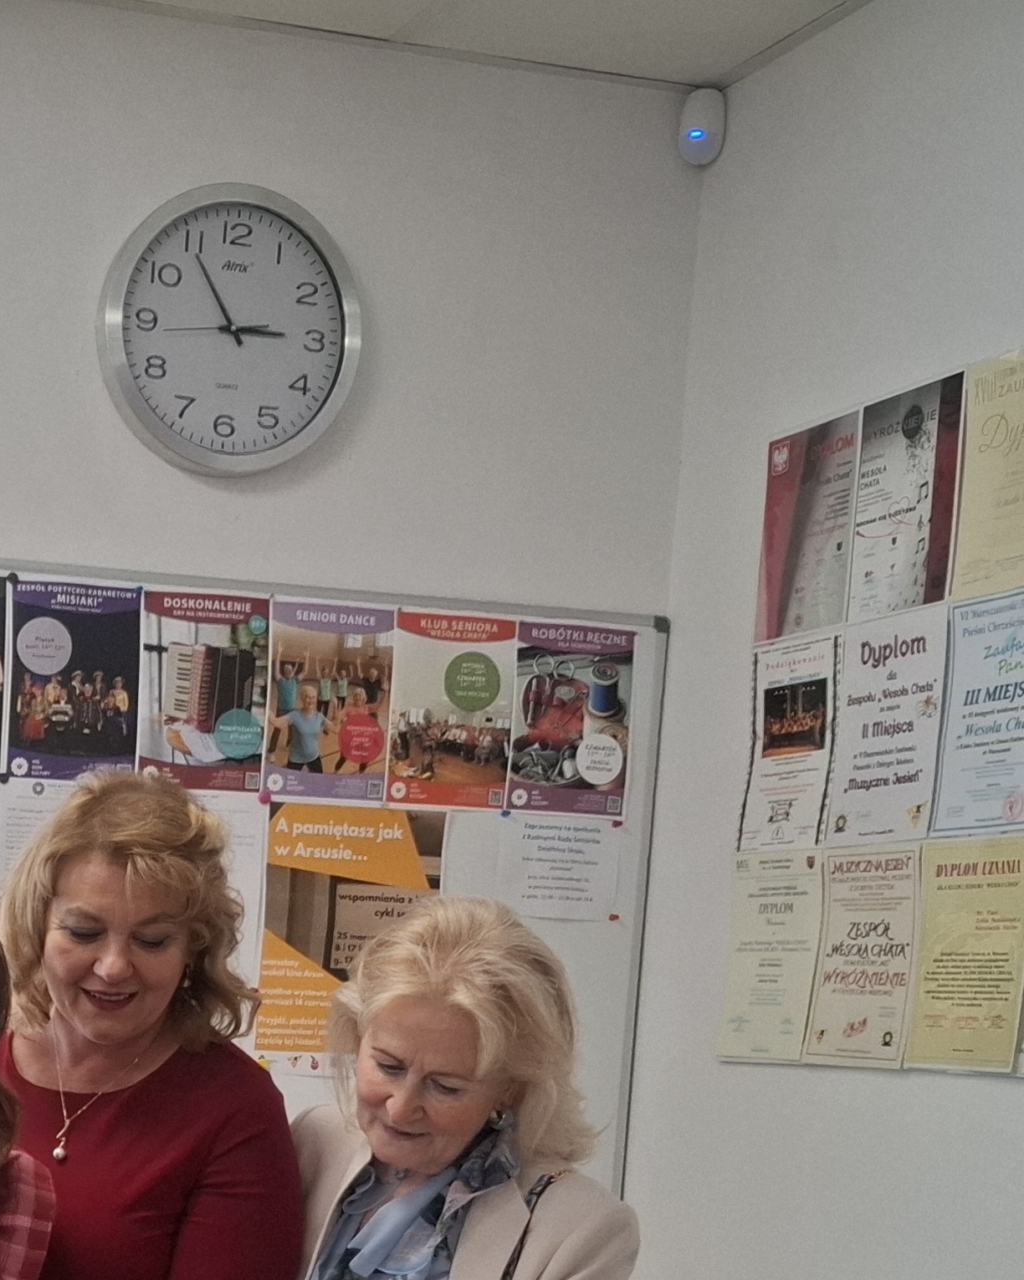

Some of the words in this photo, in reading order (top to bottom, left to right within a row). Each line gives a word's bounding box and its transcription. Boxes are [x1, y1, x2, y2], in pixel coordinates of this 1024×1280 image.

[184, 228, 204, 254] 11
[222, 219, 254, 248] 12
[276, 240, 283, 265] 1
[150, 260, 182, 288] 10
[295, 281, 319, 307] 2
[134, 307, 159, 333] 9
[302, 329, 326, 354] 3
[143, 355, 168, 380] 8
[287, 373, 311, 396] 4
[174, 394, 196, 419] 7
[256, 405, 280, 430] 5
[212, 414, 236, 438] 6
[163, 597, 252, 613] DOSKONALENIE
[296, 609, 336, 623] SENIOR
[339, 613, 376, 627] DANCE
[420, 618, 448, 630] KLUB
[451, 621, 499, 633] SENIORA
[531, 626, 585, 641] ROBÓTKI
[586, 631, 628, 646] RĘCZNE
[860, 633, 927, 669] Dyplom
[963, 688, 982, 706] III
[872, 719, 914, 738] Miejsca
[275, 817, 289, 833] A
[292, 820, 375, 841] pamiętasz
[376, 822, 403, 843] jak
[274, 845, 290, 857] w
[293, 841, 368, 862] Arsusie...
[936, 861, 979, 878] DYPLOM
[338, 892, 405, 904] wspomnienia
[759, 902, 794, 915] DYPLOM
[374, 907, 395, 920] cykl
[337, 931, 348, 940] 25
[847, 918, 895, 941] ZESPÓŁ
[262, 960, 299, 969] warsztaty
